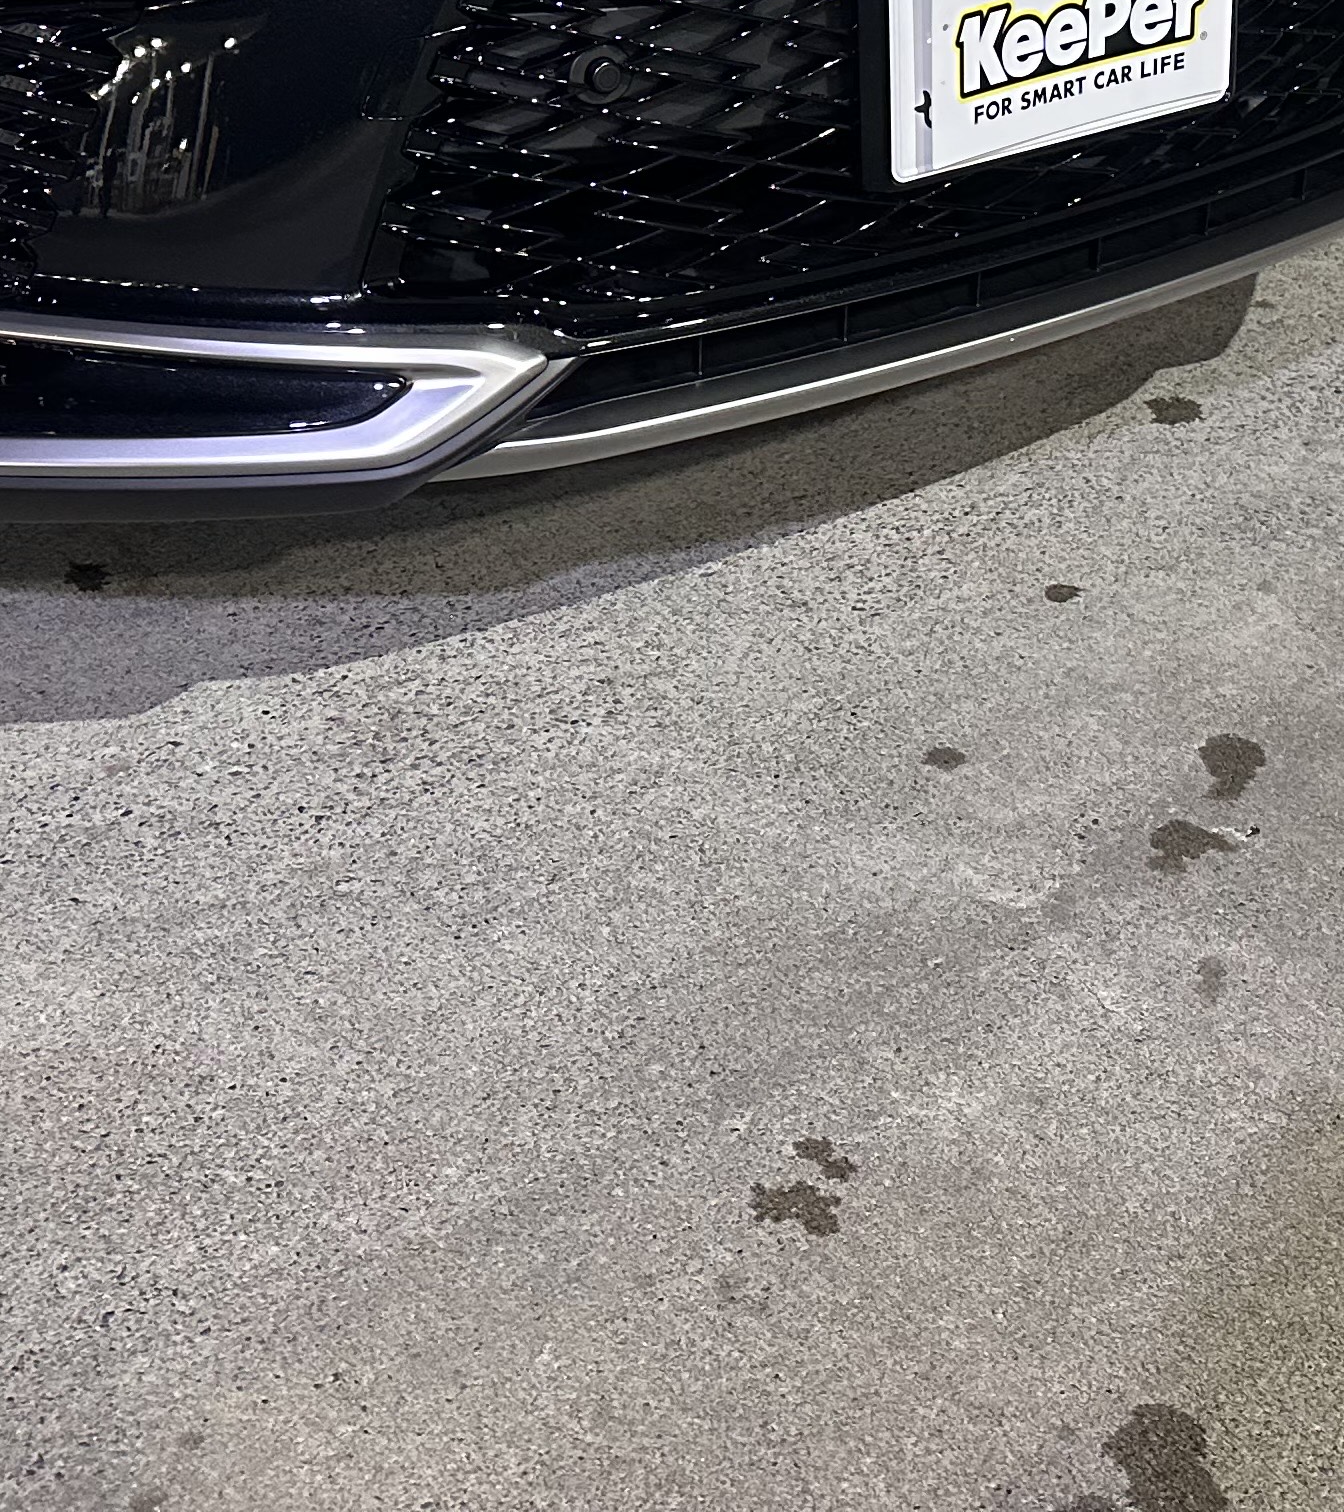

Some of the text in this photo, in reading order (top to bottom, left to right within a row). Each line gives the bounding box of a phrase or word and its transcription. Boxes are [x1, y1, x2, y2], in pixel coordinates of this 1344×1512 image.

[973, 52, 1186, 125] FOR SMART CAR LIFE
